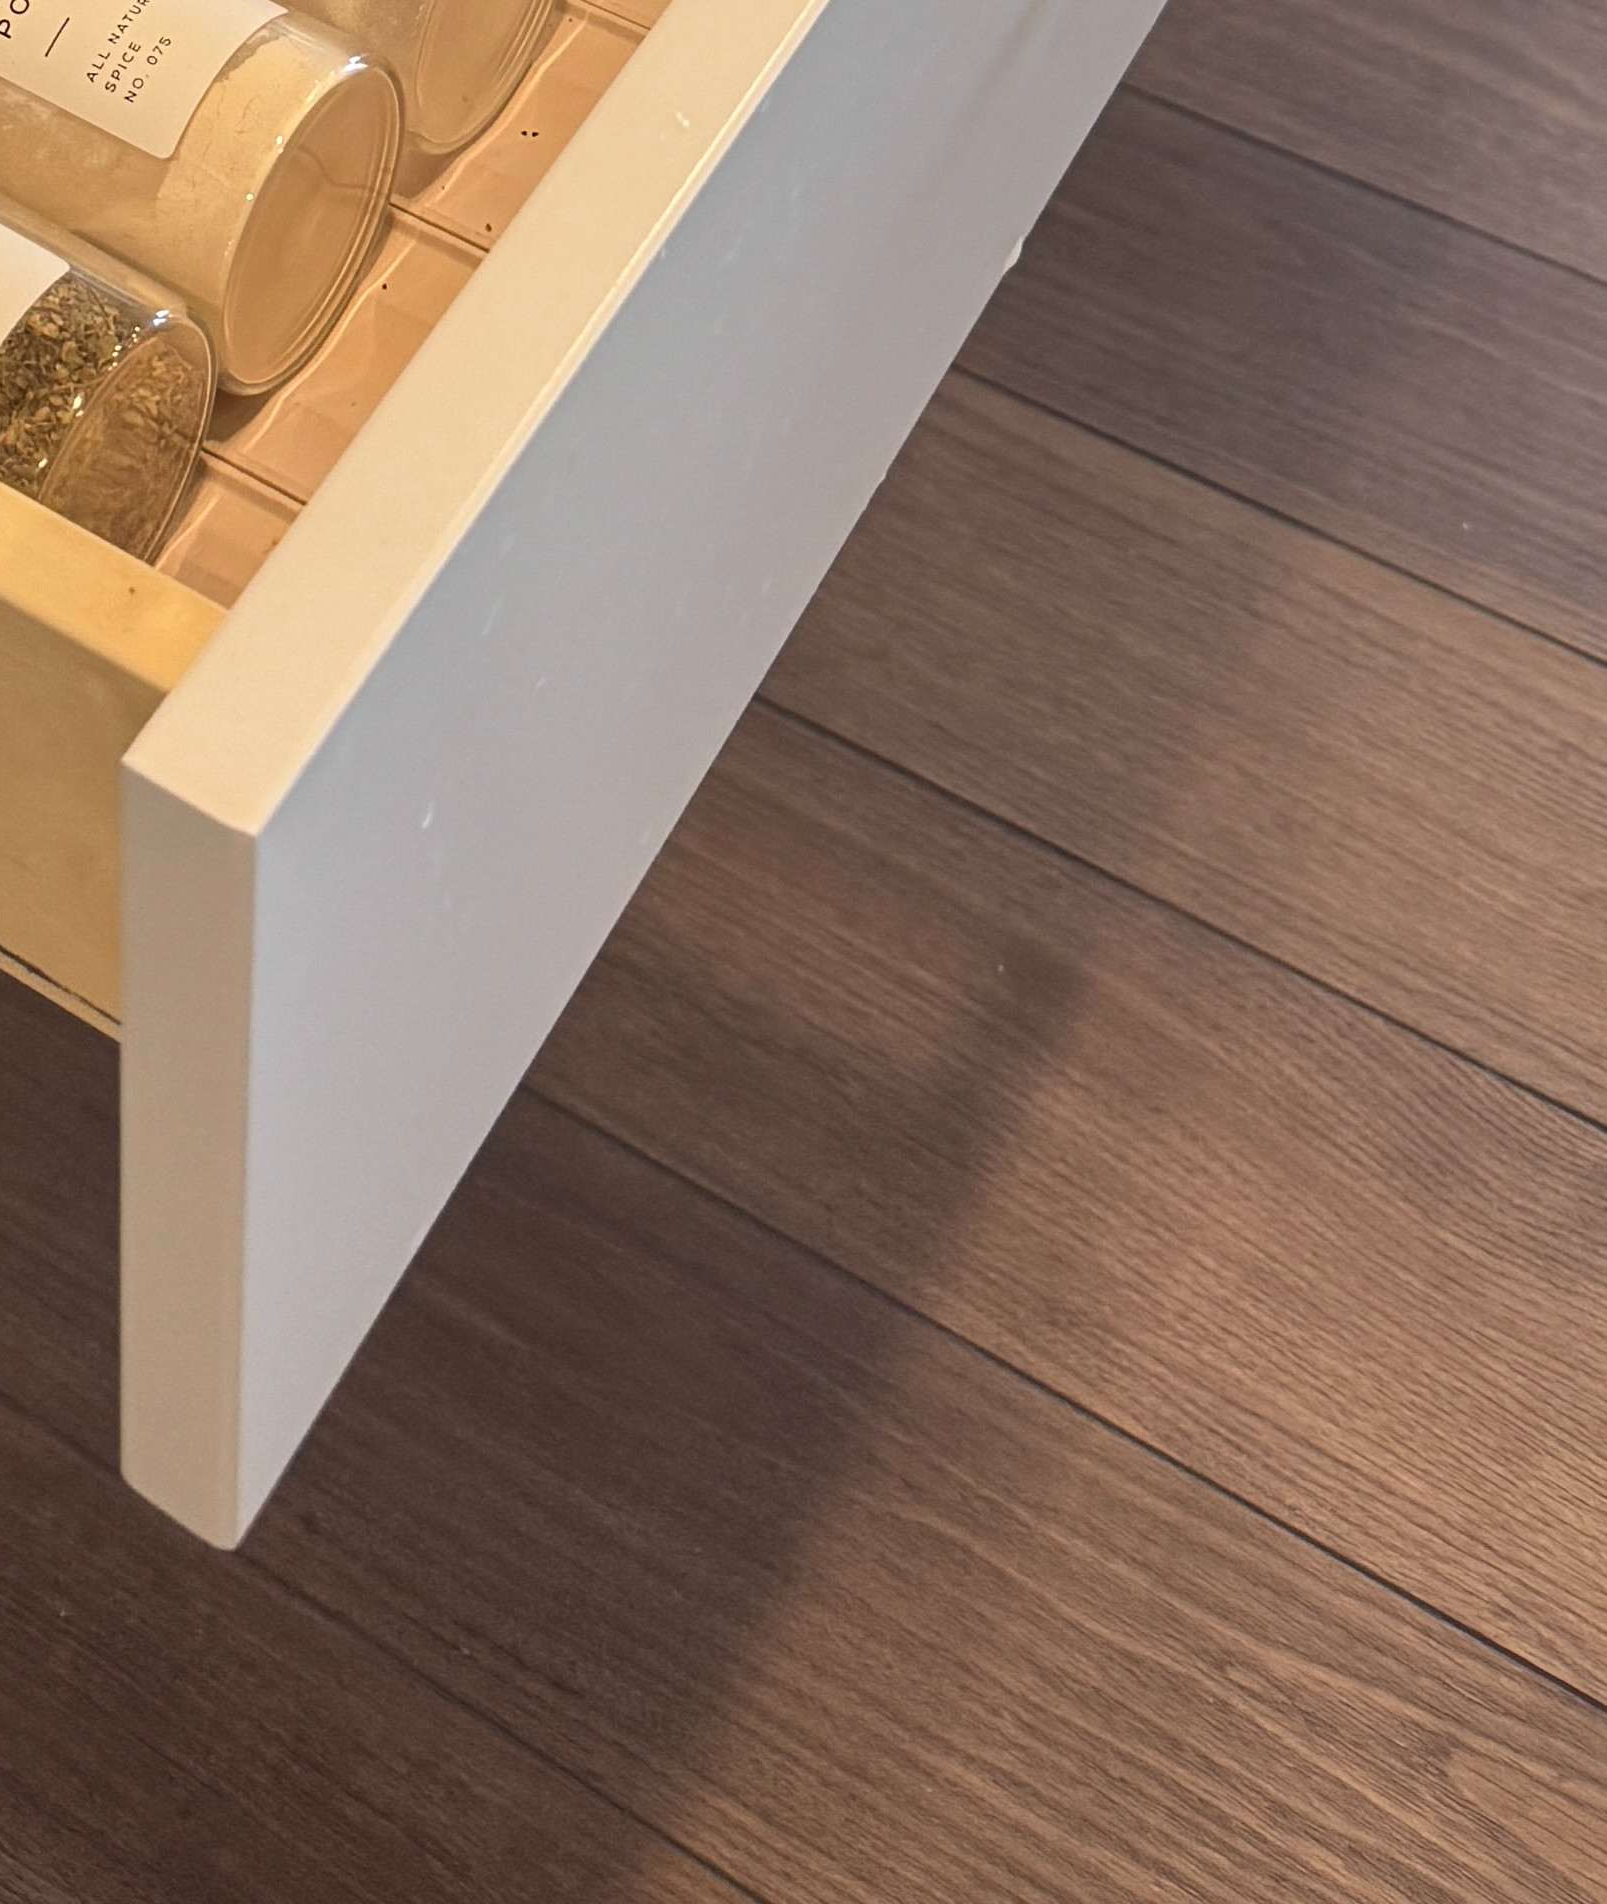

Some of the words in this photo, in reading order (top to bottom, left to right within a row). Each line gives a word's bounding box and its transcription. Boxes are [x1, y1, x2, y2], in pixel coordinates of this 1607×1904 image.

[86, 50, 111, 83] ALL
[104, 40, 142, 93] SPICE
[124, 73, 150, 104] NO.
[146, 36, 172, 66] 075
